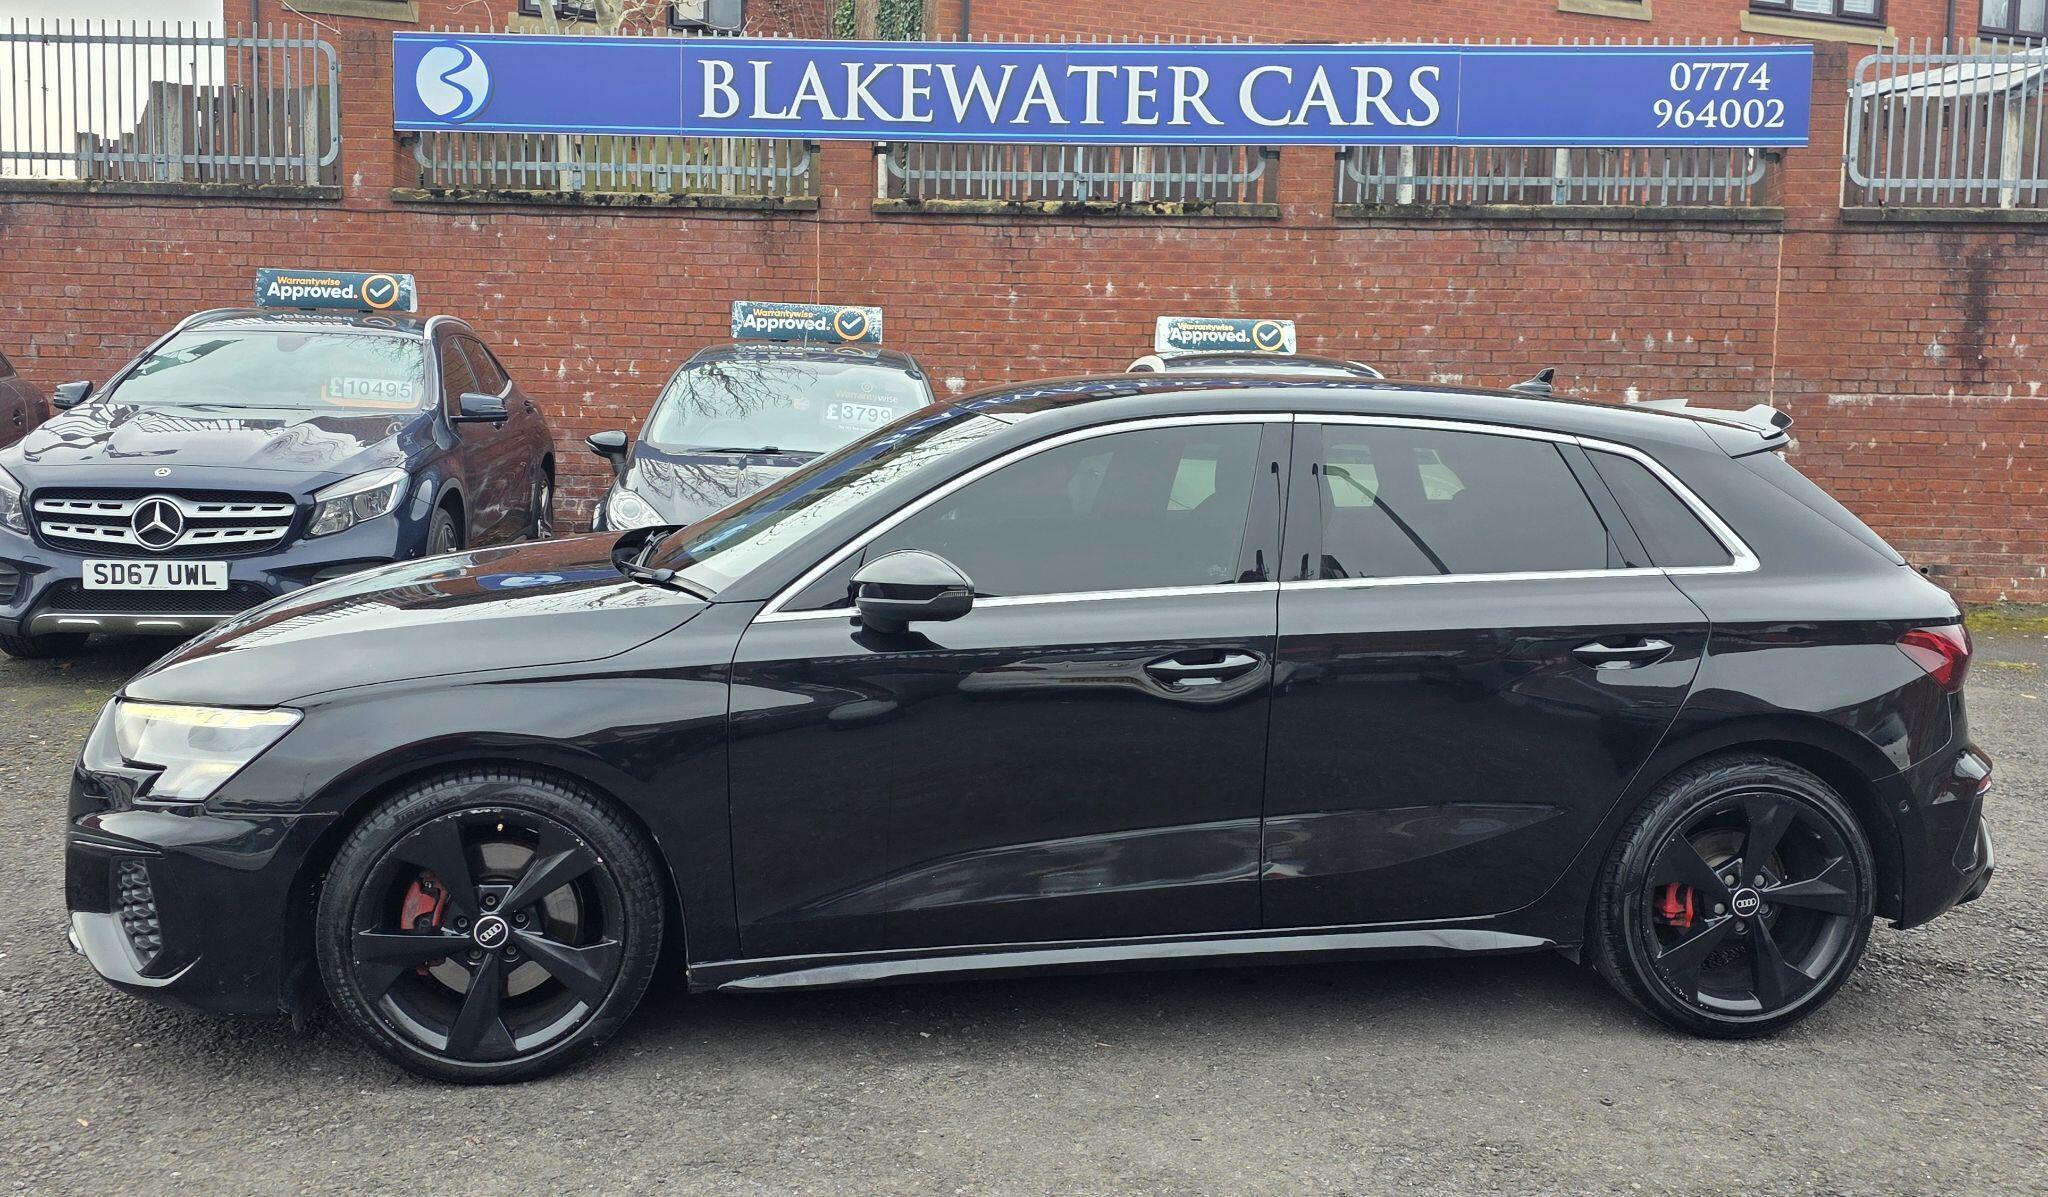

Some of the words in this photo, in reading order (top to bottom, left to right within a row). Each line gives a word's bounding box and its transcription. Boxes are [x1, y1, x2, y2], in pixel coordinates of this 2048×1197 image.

[1669, 62, 1771, 91] 07774
[697, 60, 1225, 125] BLAKEWATER
[1239, 65, 1441, 126] CARS
[1653, 99, 1785, 128] 964002
[267, 282, 359, 300] Approved.
[277, 276, 340, 287] Warrantywise
[744, 314, 831, 332] Approved.
[1170, 327, 1251, 344] Approved.
[329, 378, 411, 399] £10495
[827, 403, 892, 423] £3799
[93, 563, 159, 585] SD67
[167, 564, 217, 586] UWL
